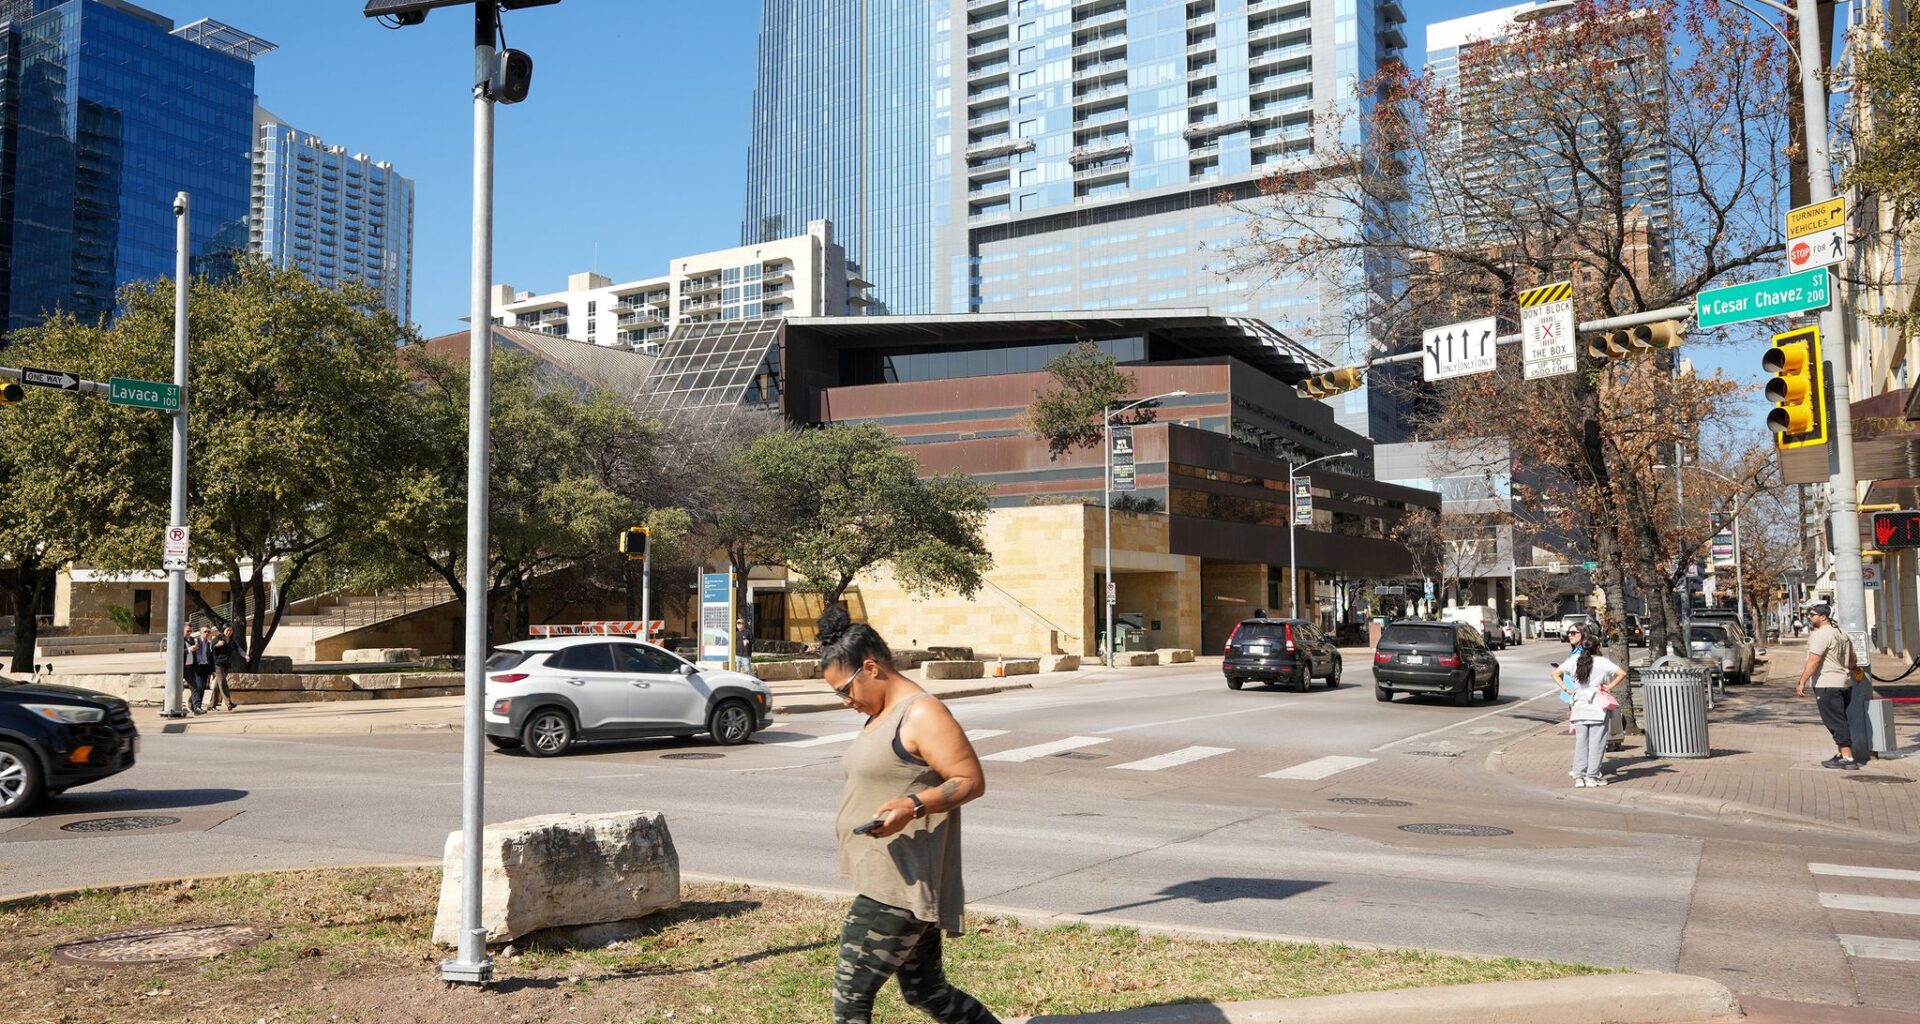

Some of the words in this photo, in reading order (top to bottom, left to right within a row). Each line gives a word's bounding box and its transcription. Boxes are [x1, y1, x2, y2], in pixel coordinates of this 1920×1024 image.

[1791, 207, 1826, 222] TURNING
[1790, 219, 1828, 235] VEHICLES
[1791, 248, 1810, 261] STOP
[1813, 243, 1826, 253] FOR
[1812, 274, 1823, 286] ST
[1714, 297, 1749, 315] Cesar
[1755, 288, 1803, 307] Chavez
[1807, 289, 1824, 303] 200
[1546, 303, 1570, 314] BLOCK
[1532, 349, 1547, 358] THE
[1550, 345, 1567, 356] BOX
[1443, 363, 1457, 373] ONLY
[1460, 360, 1475, 370] ONLY
[1477, 357, 1493, 368] ONLY
[1537, 361, 1548, 369] UP
[1551, 359, 1562, 367] TO
[1552, 364, 1569, 374] FINE
[27, 372, 44, 382] ONE
[46, 375, 63, 384] WAY
[112, 384, 159, 402] Lavaca
[167, 387, 177, 396] ST
[163, 397, 177, 407] 100
